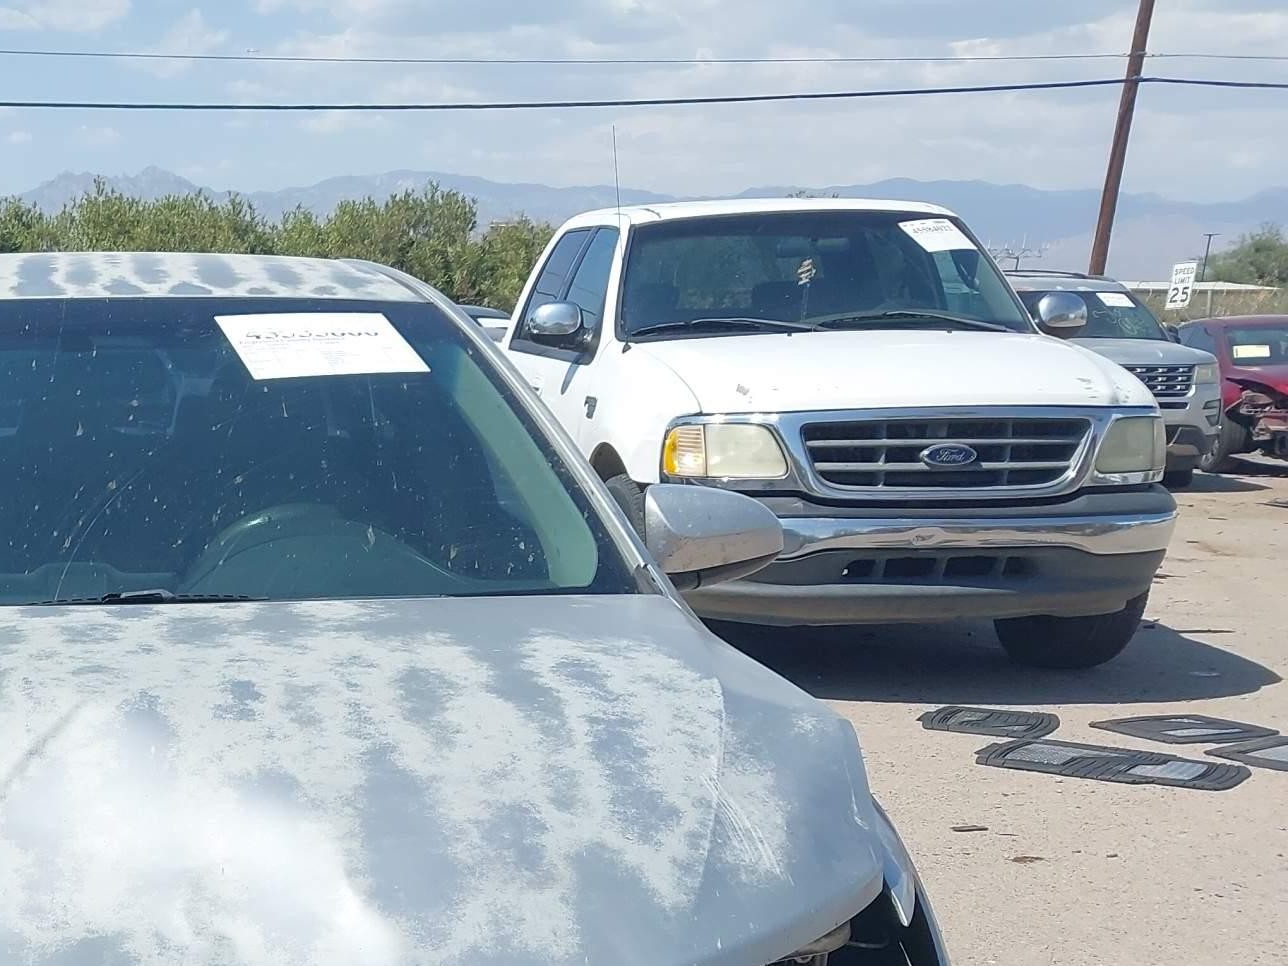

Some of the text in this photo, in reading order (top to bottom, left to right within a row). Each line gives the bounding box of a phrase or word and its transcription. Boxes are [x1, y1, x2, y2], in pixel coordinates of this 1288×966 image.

[1174, 266, 1195, 276] SPEED
[1174, 276, 1191, 285] LIMIT
[1169, 286, 1190, 303] 25
[936, 448, 966, 461] Ford
